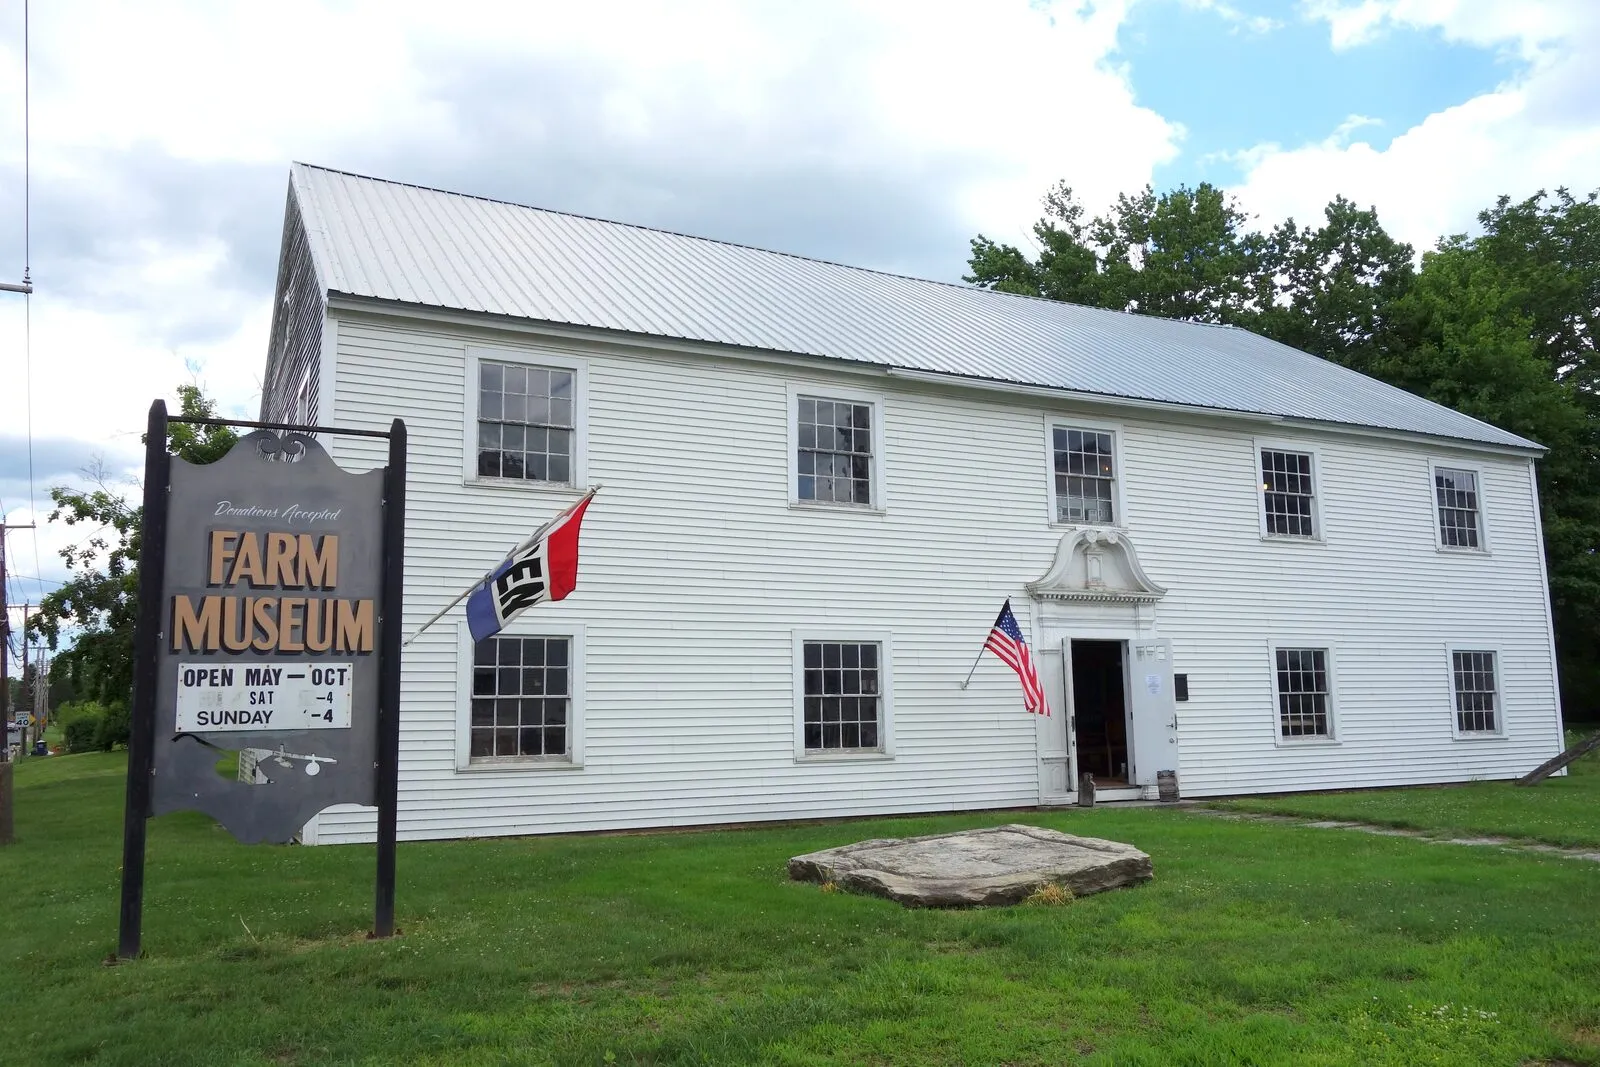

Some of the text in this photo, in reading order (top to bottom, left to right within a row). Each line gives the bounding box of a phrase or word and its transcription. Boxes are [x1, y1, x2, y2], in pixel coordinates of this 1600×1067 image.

[214, 500, 341, 524] Donations Accepted
[208, 530, 338, 590] FARM
[496, 543, 545, 620] EN
[170, 595, 374, 653] MUSEUM
[183, 668, 234, 687] OPEN
[250, 691, 274, 705] SAT
[197, 709, 334, 726] SUNDAY -4
